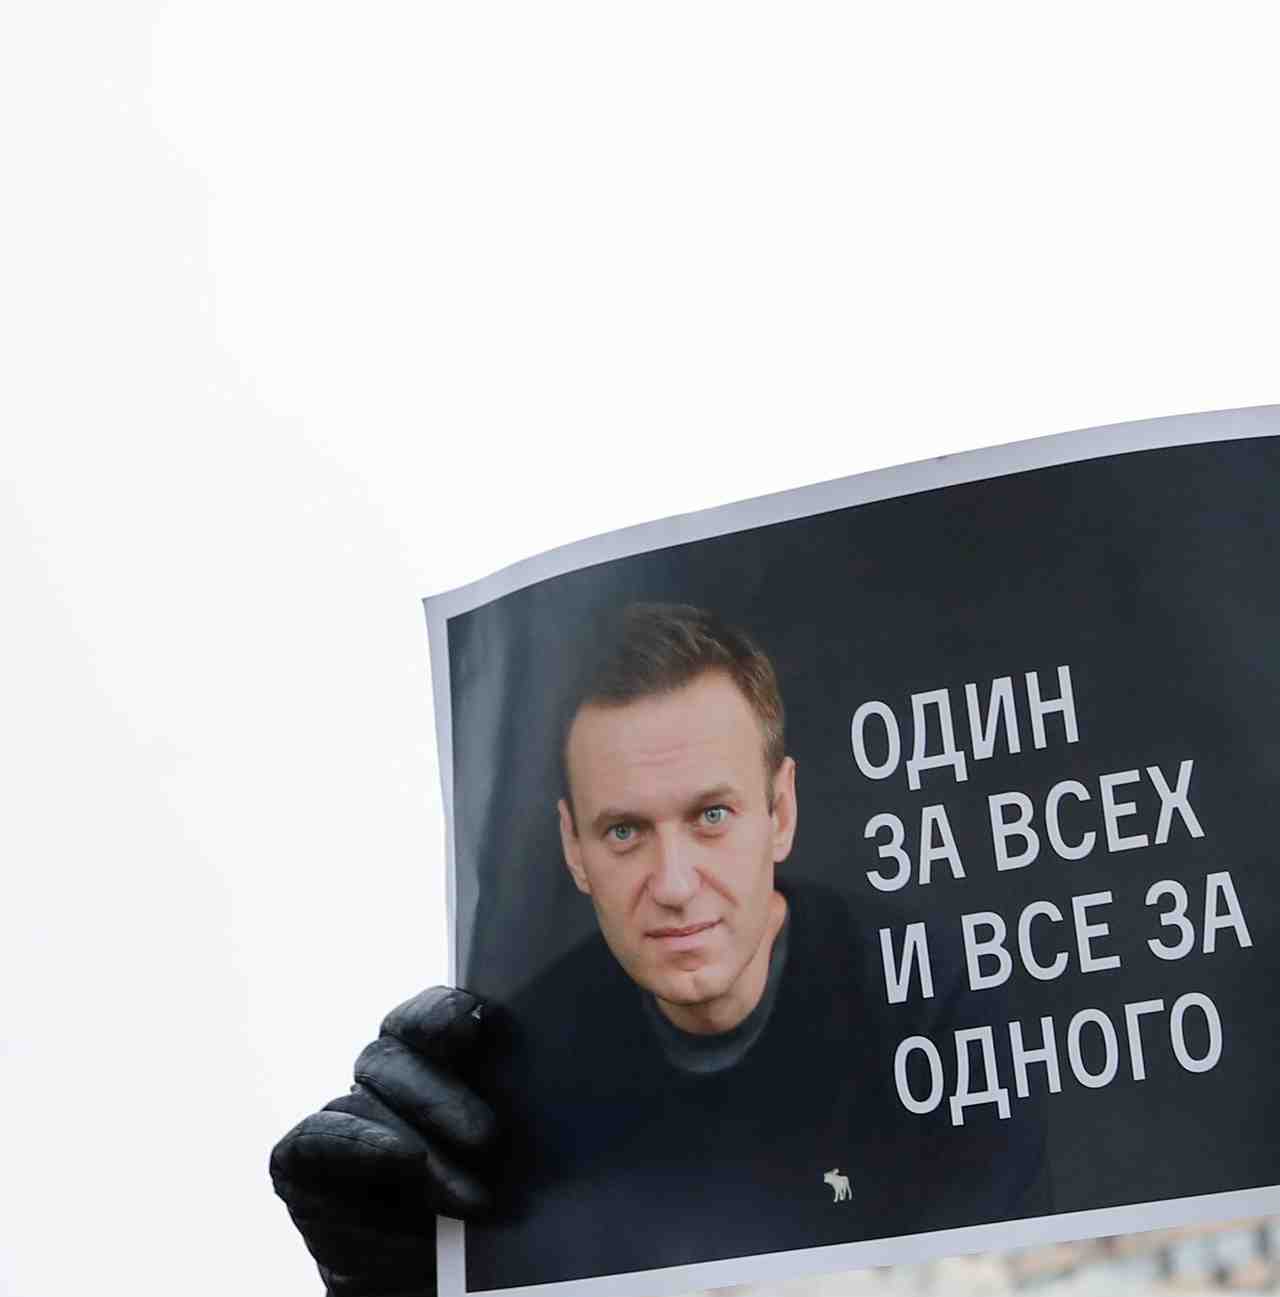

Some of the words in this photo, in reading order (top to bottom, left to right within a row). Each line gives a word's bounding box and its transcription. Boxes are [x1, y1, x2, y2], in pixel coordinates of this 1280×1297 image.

[851, 665, 1080, 791] ОДИН
[863, 804, 966, 892] ЗА
[987, 759, 1206, 872] ВСЕХ
[879, 921, 935, 1004] И
[961, 890, 1121, 991] ВСЕ
[1145, 871, 1253, 961] ЗА
[894, 992, 1223, 1127] ОДНОГО
